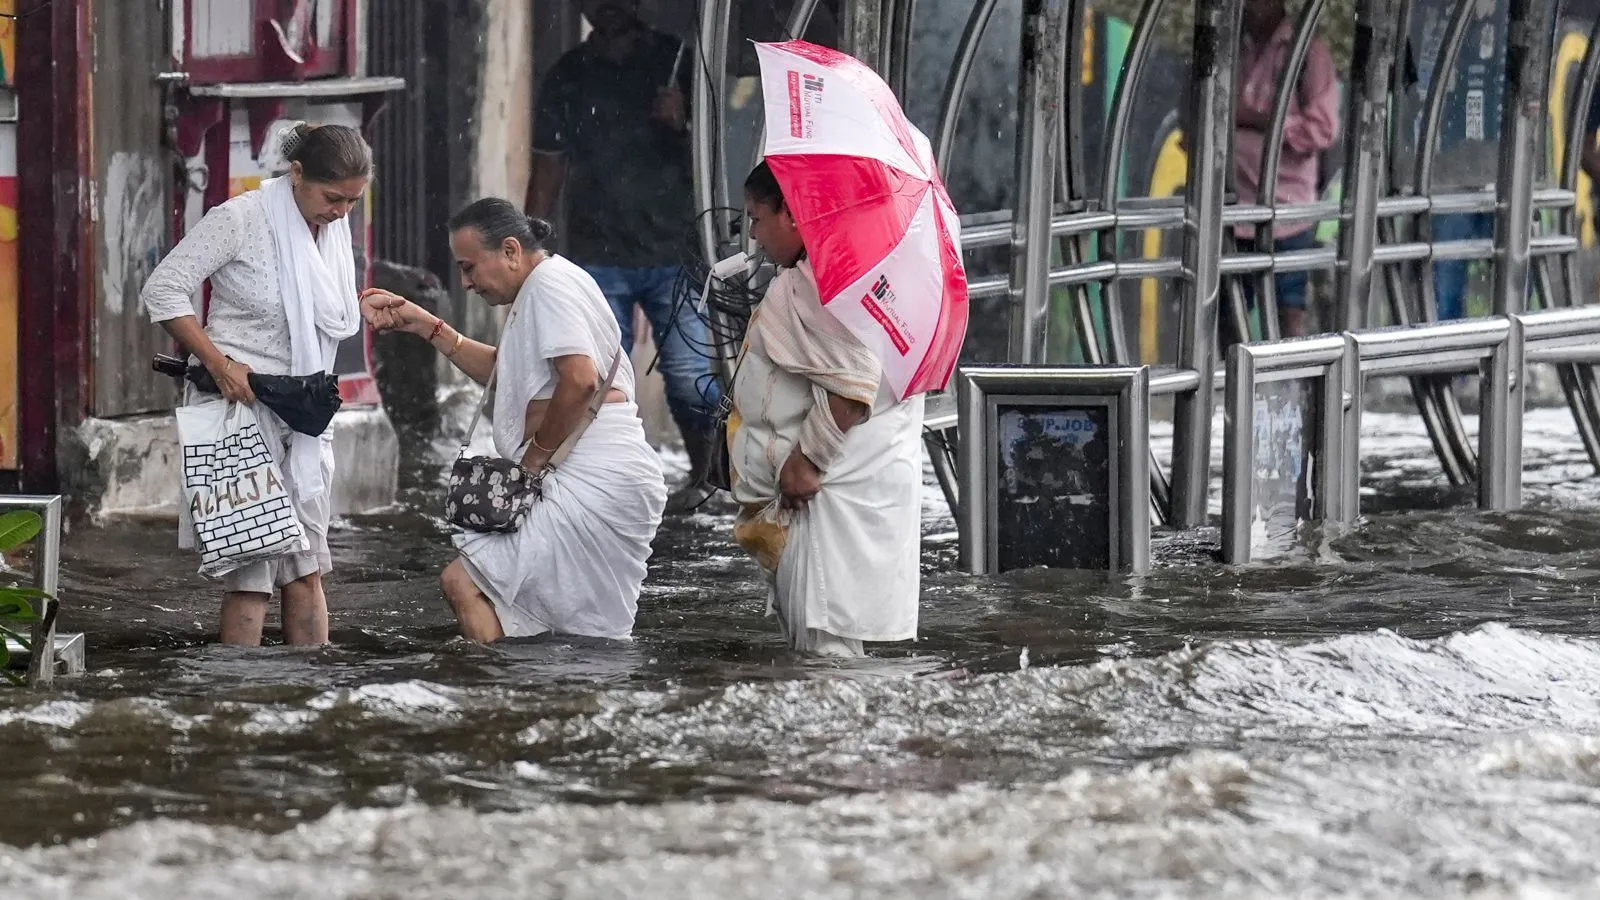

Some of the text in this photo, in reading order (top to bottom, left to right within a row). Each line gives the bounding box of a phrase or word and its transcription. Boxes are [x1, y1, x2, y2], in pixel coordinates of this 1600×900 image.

[805, 120, 814, 139] FUND
[887, 290, 896, 302] ITI
[881, 298, 915, 344] MUTUAL FUND
